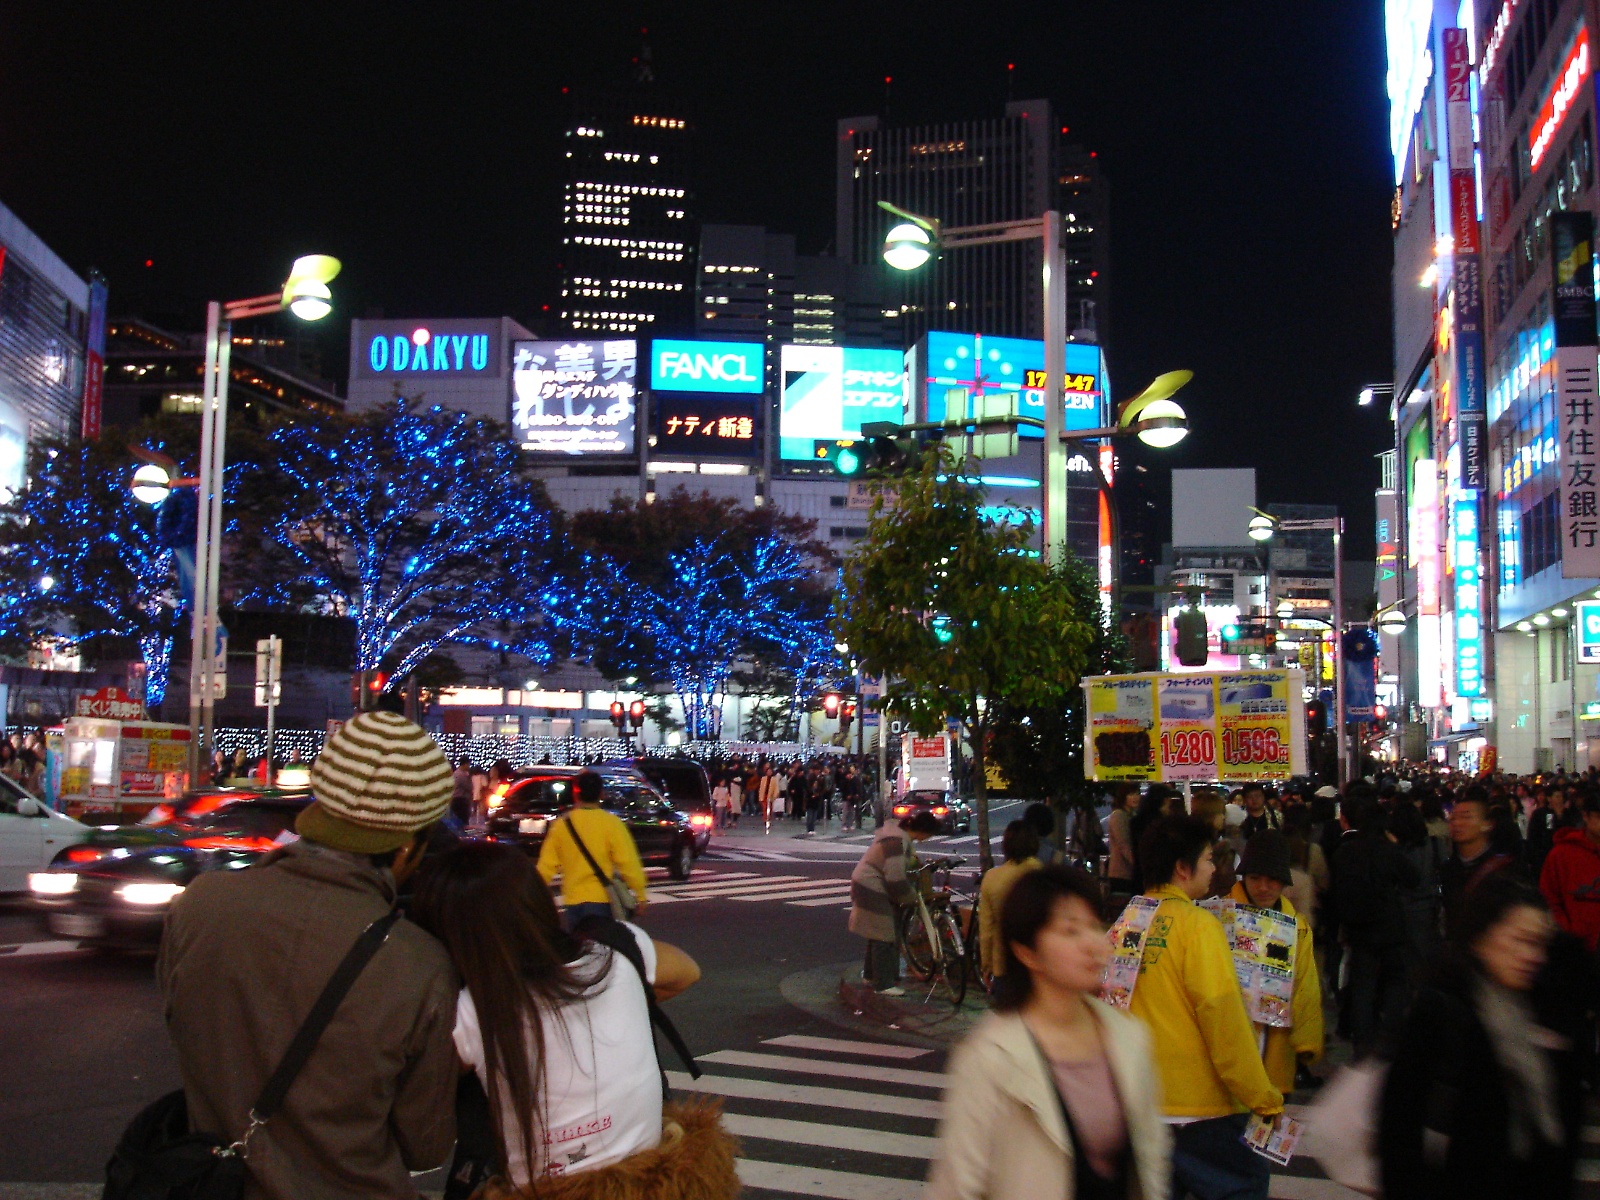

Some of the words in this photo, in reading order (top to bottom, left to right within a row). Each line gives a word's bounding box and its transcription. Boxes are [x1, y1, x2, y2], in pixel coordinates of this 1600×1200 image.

[1557, 286, 1593, 297] SMBC
[371, 328, 488, 371] ODAKYU
[660, 352, 757, 381] FANCL
[1025, 389, 1095, 410] CIZEN
[667, 416, 753, 439] ナティ新登
[1565, 368, 1598, 548] 三井住友銀行
[1380, 542, 1396, 581] ALTA
[80, 699, 141, 718] 宝くじ発売中
[1160, 731, 1216, 767] 1,280
